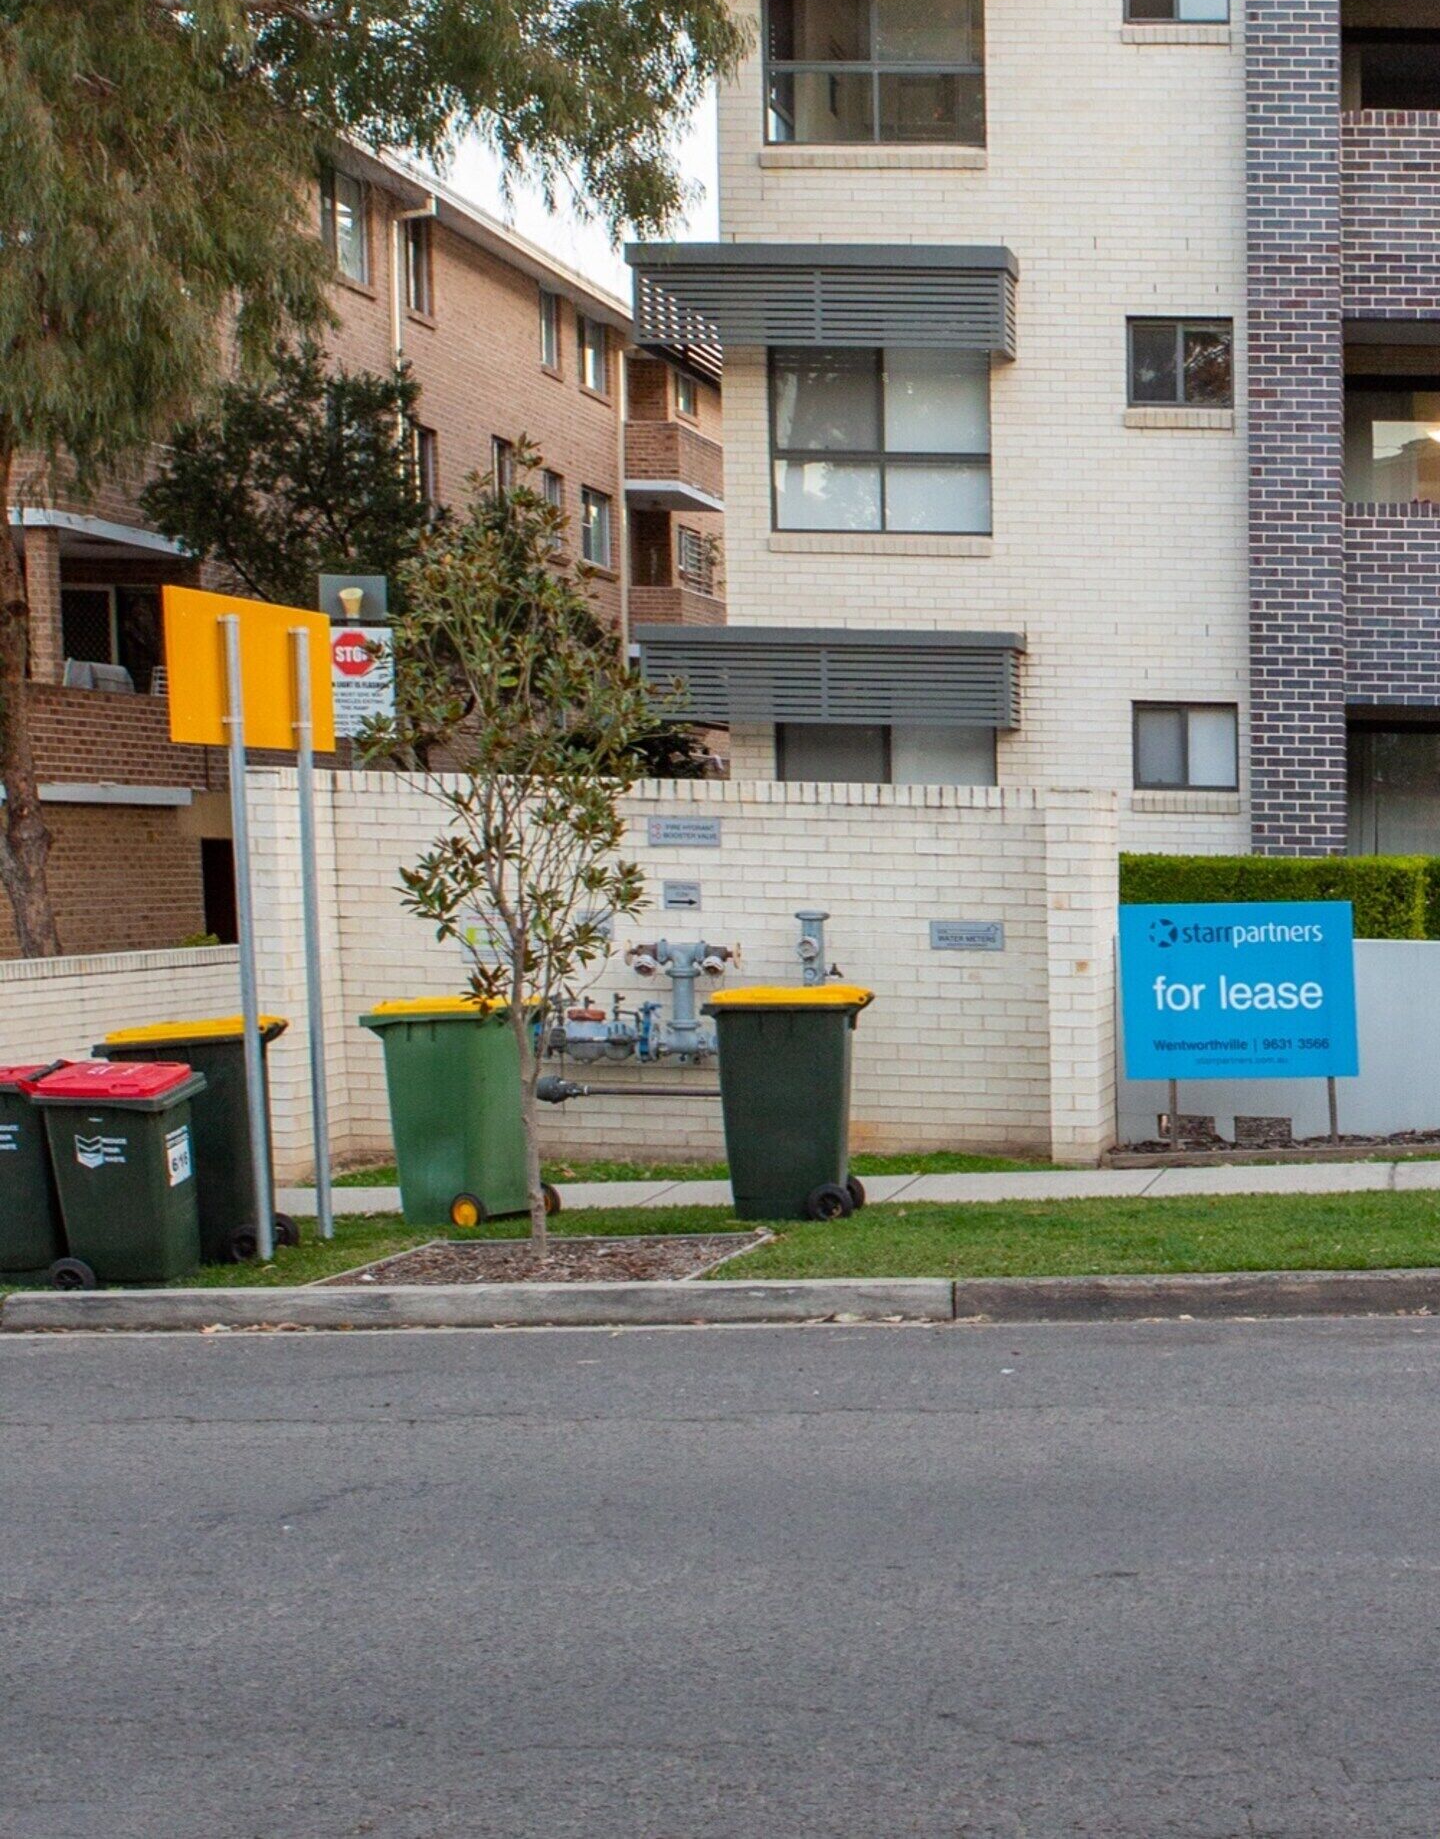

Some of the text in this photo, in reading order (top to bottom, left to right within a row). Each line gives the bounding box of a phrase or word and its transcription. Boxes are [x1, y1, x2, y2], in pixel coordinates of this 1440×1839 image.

[965, 935, 996, 943] METERS
[1182, 922, 1323, 948] starrpartners
[1152, 974, 1324, 1011] for lease
[1153, 1038, 1330, 1051] Wentworthville 9631 3566
